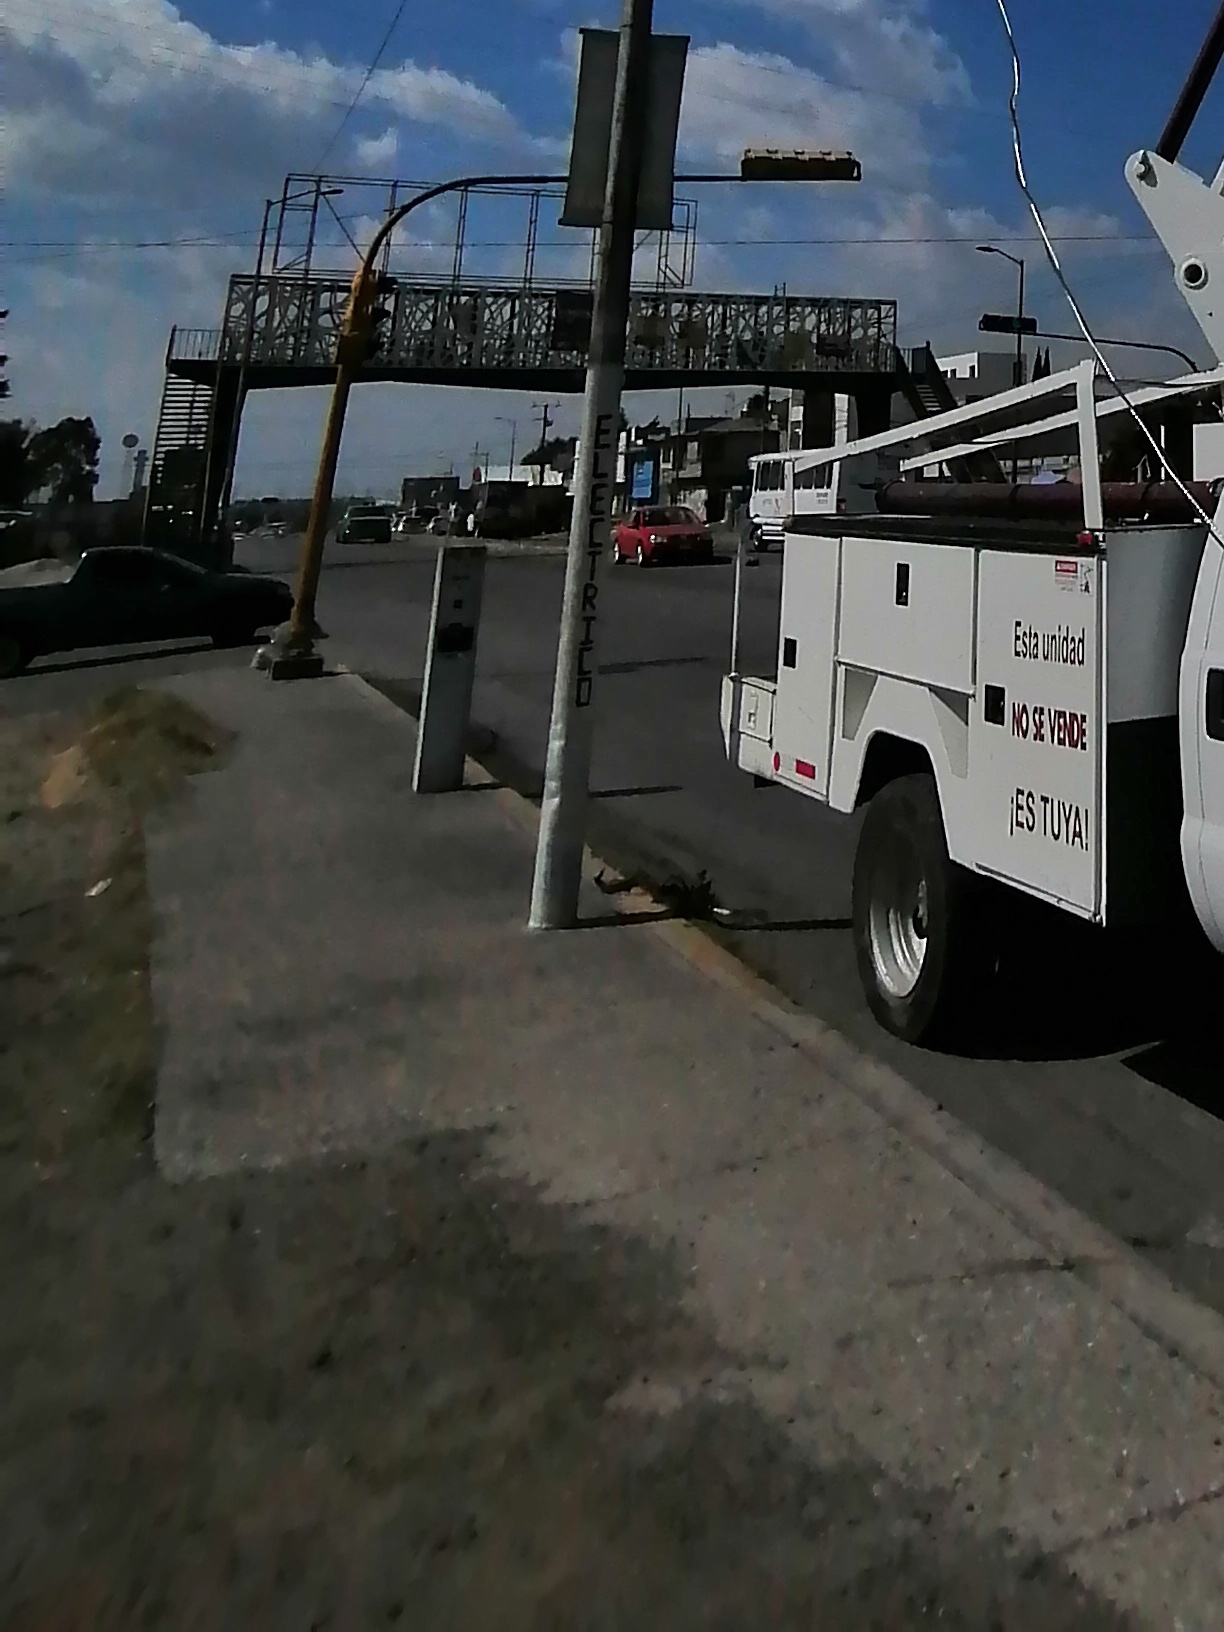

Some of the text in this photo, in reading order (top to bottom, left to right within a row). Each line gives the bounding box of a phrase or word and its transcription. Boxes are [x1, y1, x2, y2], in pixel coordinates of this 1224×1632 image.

[1014, 620, 1085, 666] Esta unidad
[1012, 701, 1087, 751] NO SE VENDE
[1010, 787, 1089, 852] ¡ES TUYA!
